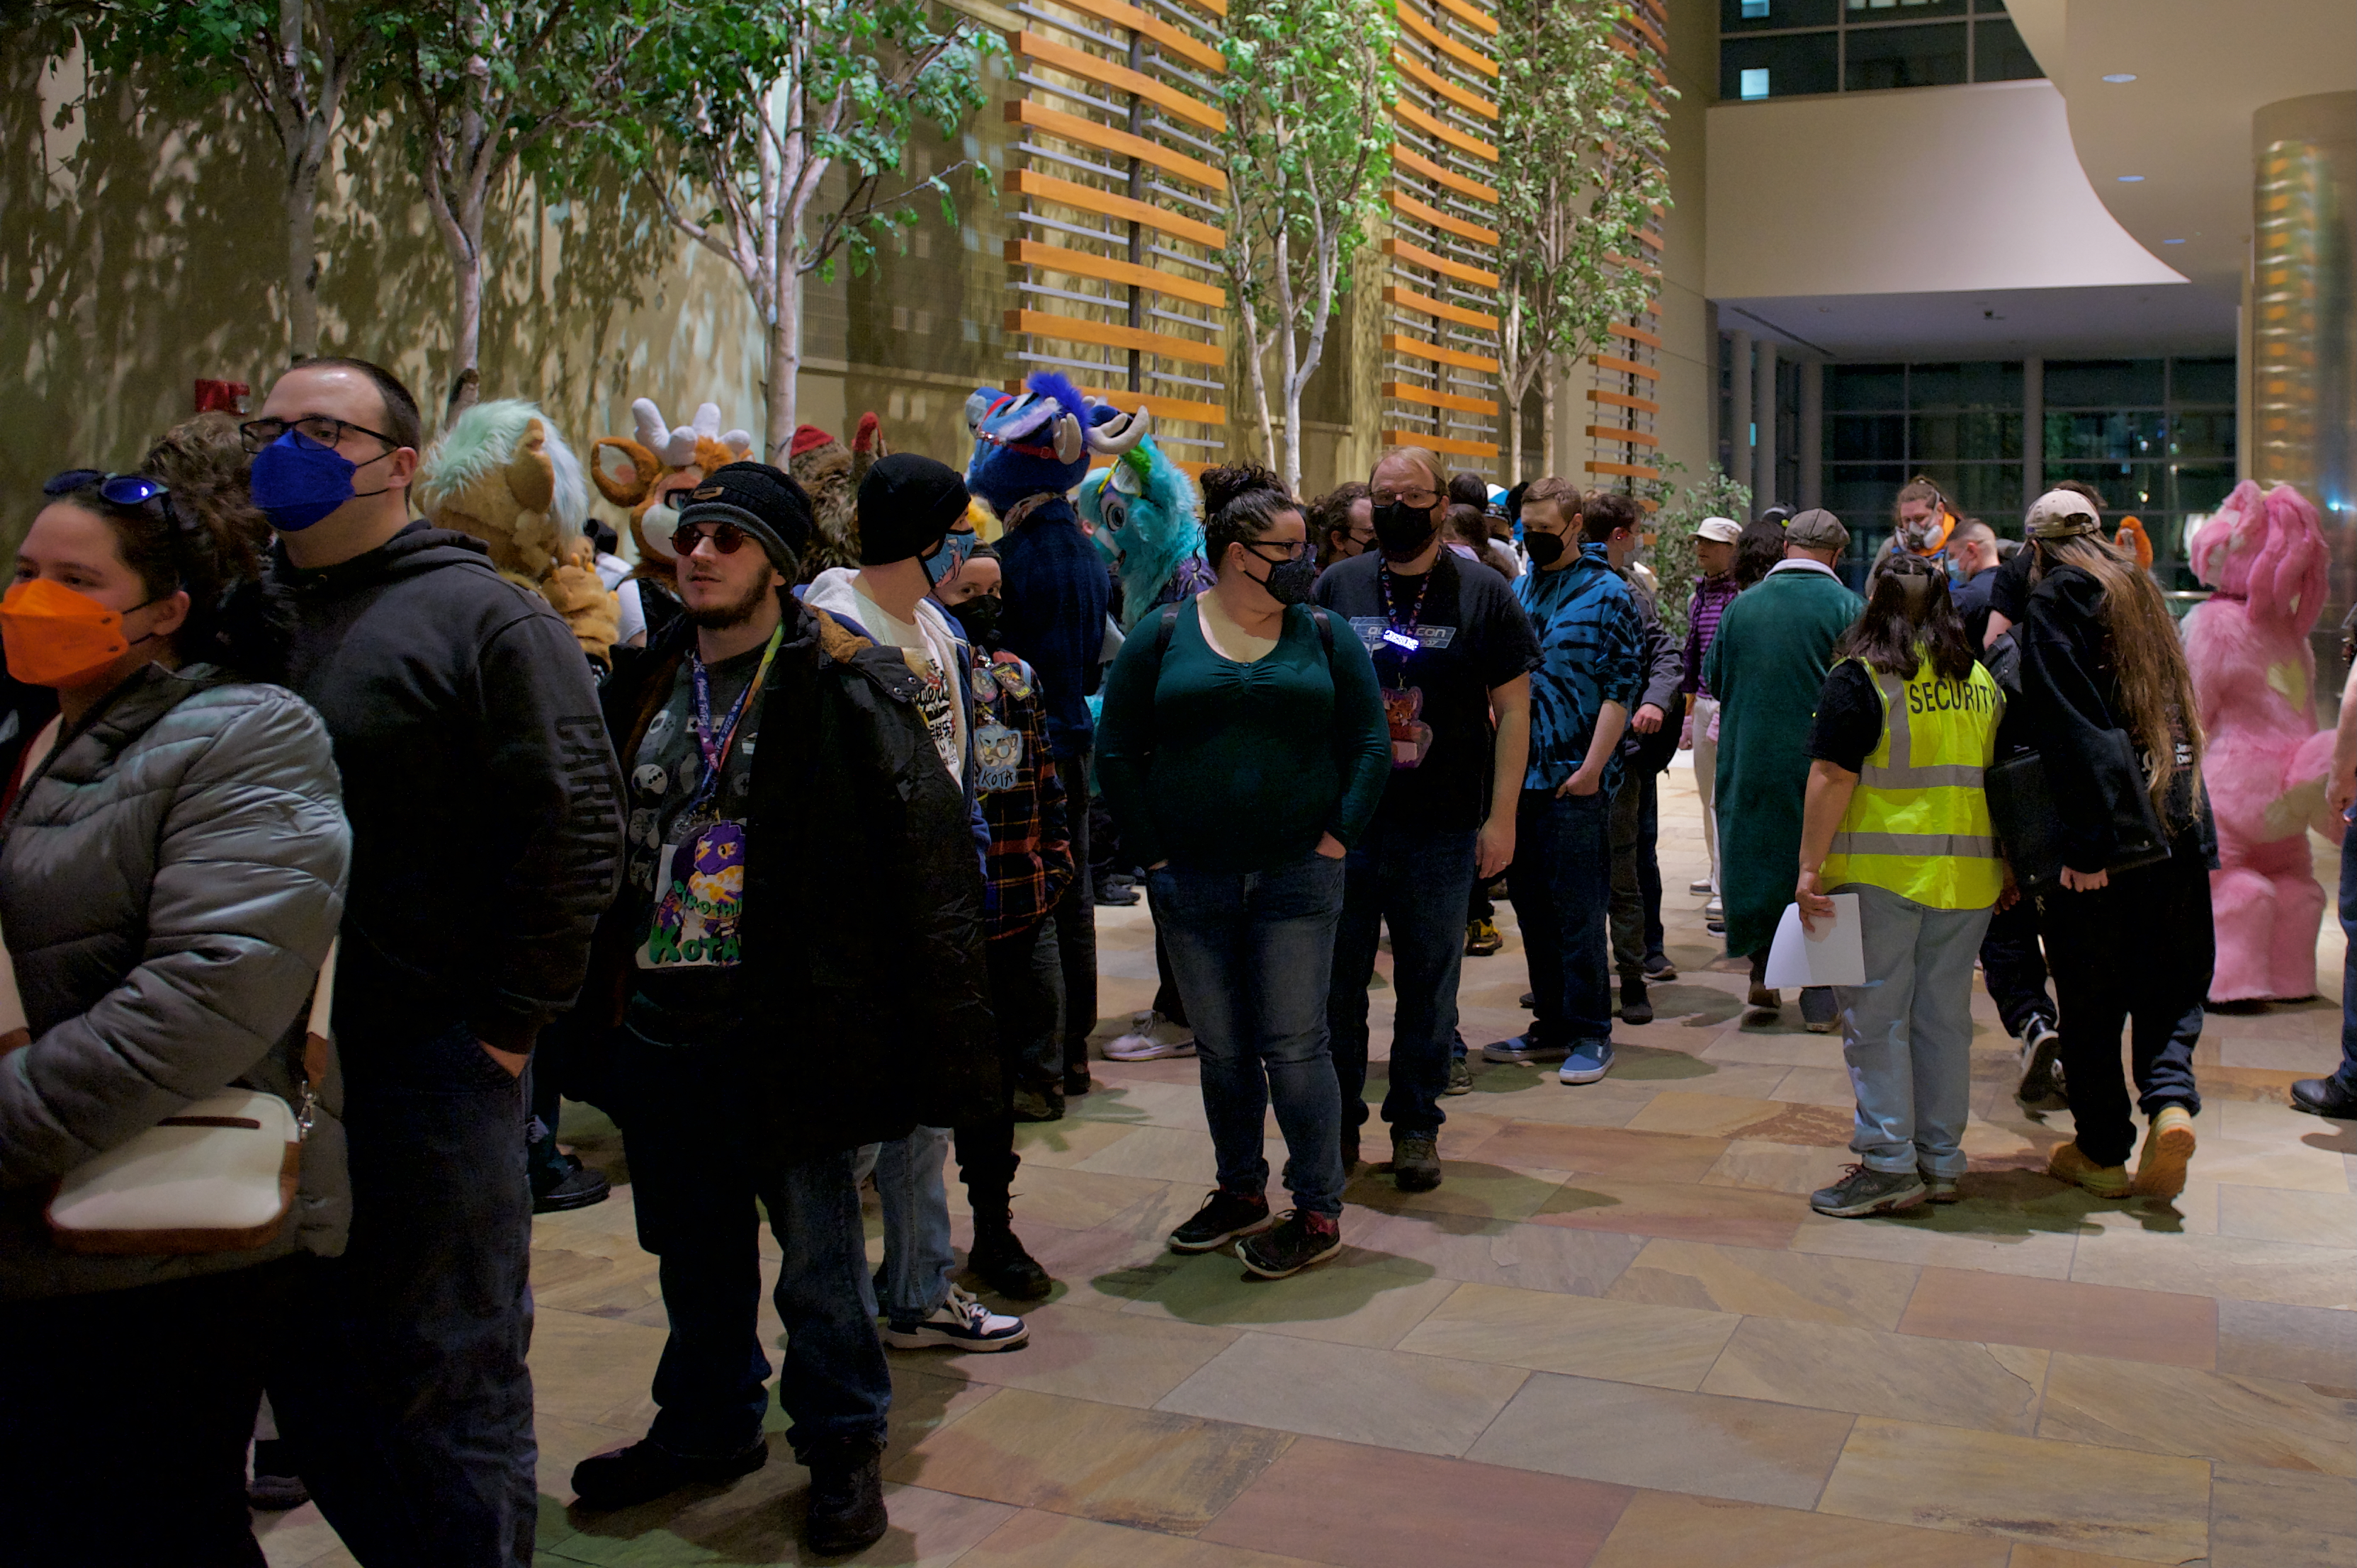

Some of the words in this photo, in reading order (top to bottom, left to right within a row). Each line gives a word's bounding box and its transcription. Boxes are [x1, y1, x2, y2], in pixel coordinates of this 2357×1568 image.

[1909, 681, 1996, 715] SECURITY
[981, 768, 1014, 787] KOTA
[649, 924, 740, 964] KOTA
